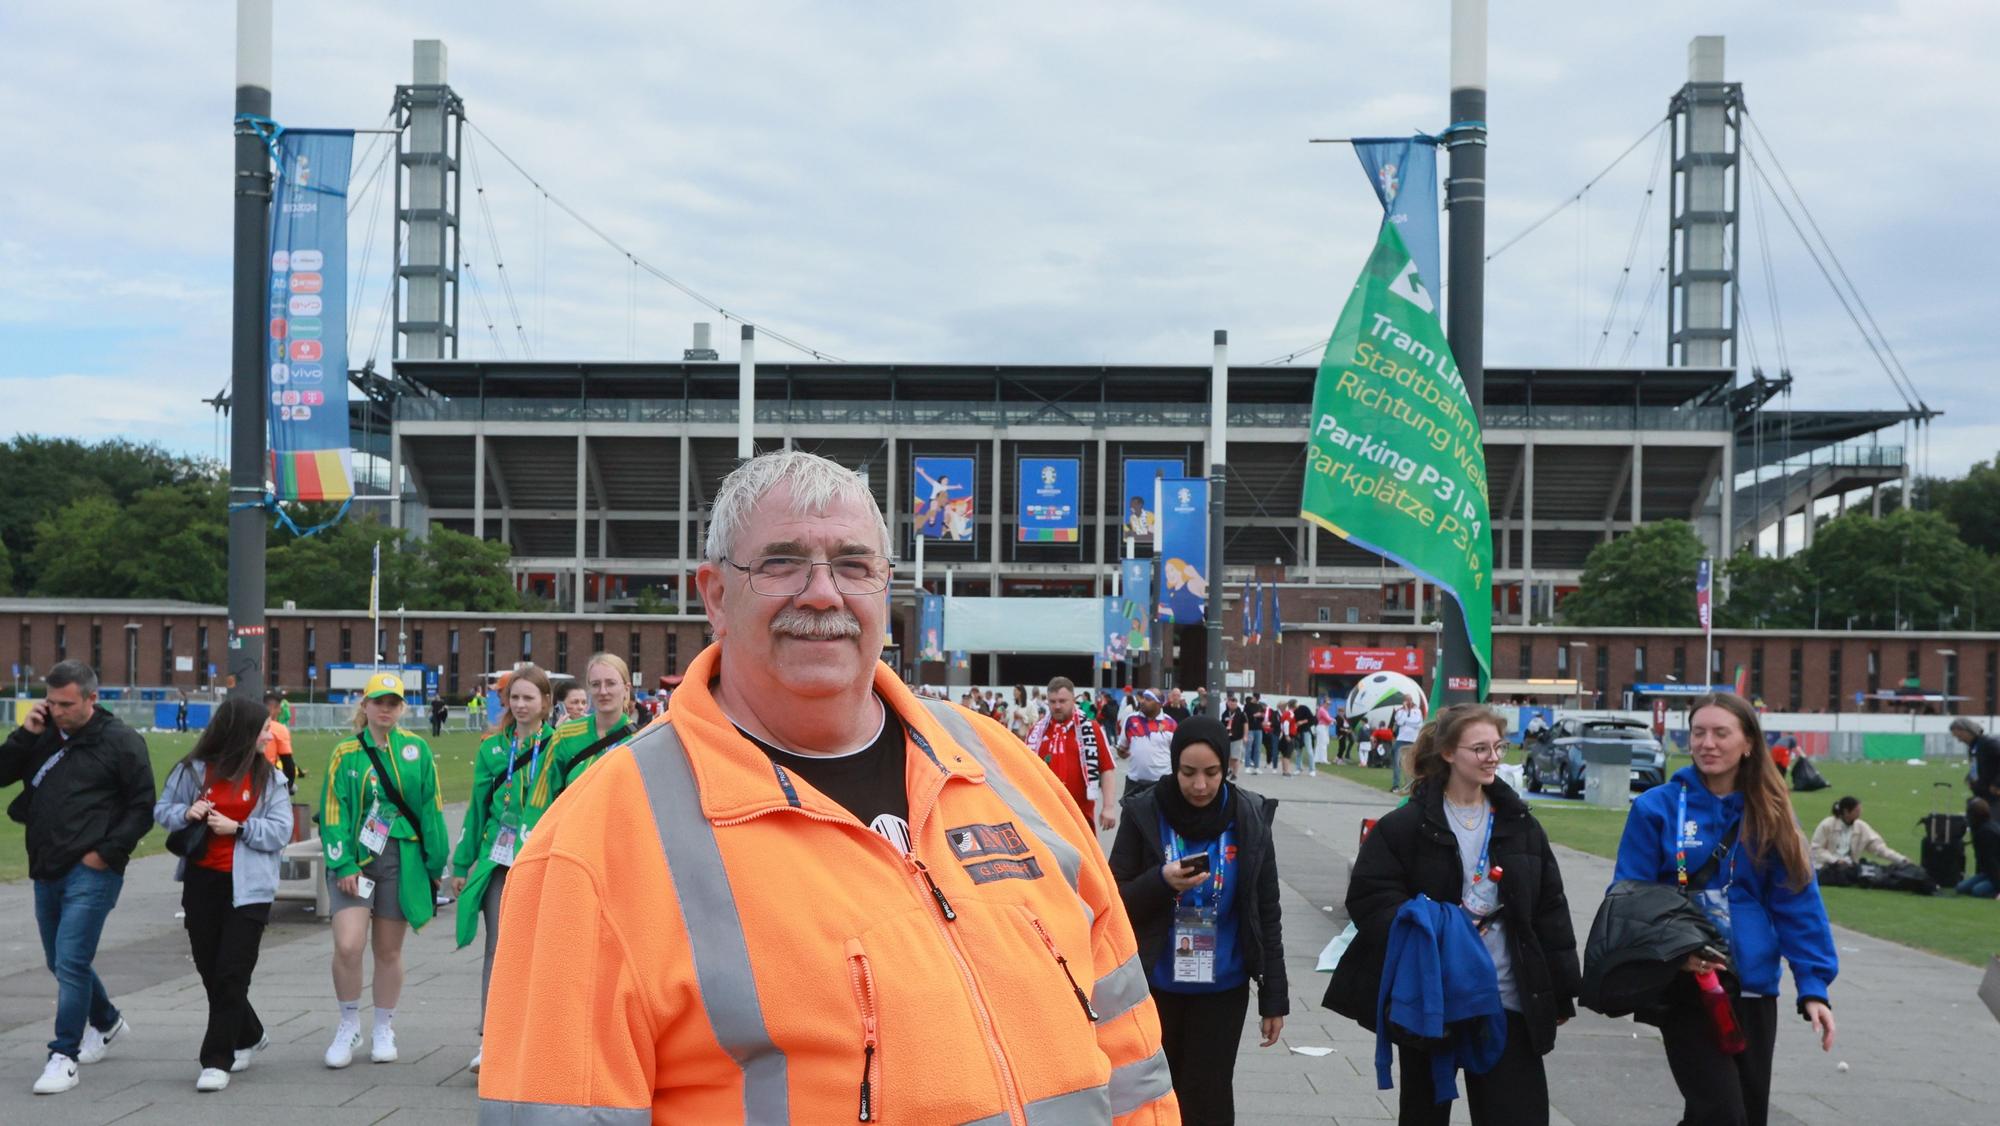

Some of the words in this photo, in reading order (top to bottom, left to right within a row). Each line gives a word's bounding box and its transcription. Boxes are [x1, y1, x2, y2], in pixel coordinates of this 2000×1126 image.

[291, 368, 322, 378] vivo
[1370, 313, 1434, 366] Tram
[1335, 371, 1453, 452] Richtung
[1350, 342, 1473, 440] Stadtbahn
[1315, 413, 1417, 481] Parking
[1417, 464, 1455, 501] P3
[1436, 513, 1469, 551] P3
